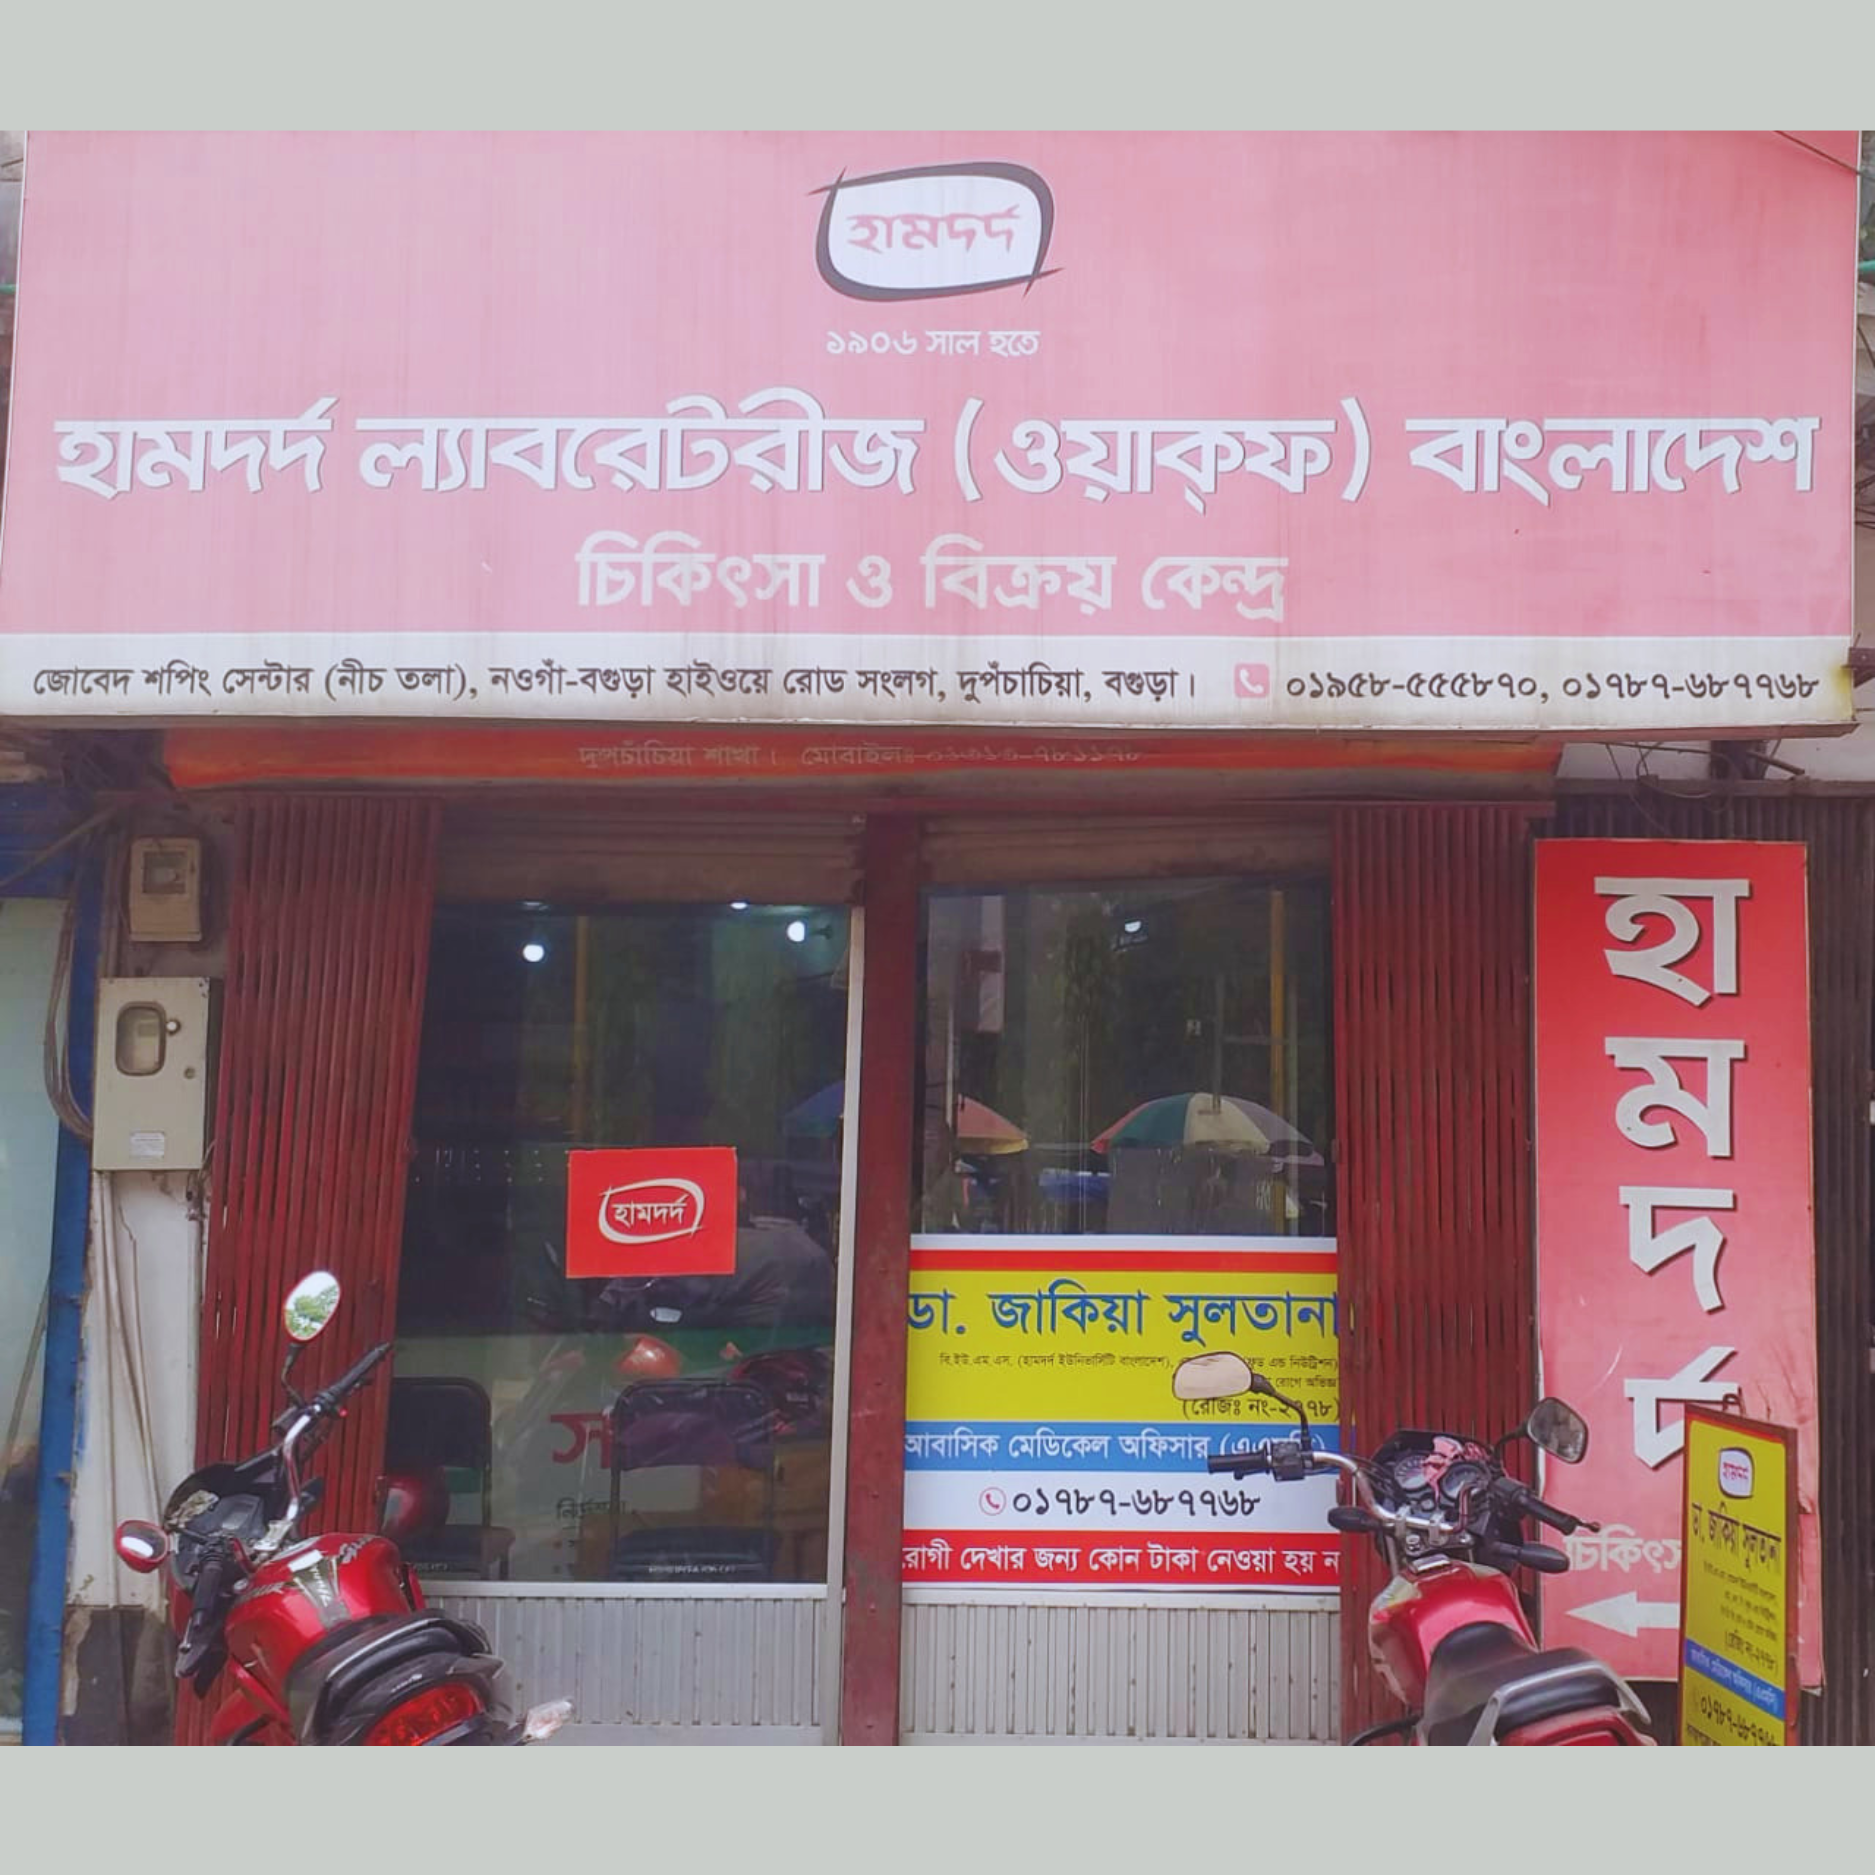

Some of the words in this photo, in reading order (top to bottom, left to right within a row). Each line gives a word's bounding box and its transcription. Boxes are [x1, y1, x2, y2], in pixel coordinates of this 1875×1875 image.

[846, 204, 1020, 254] হামদর্দ
[826, 330, 918, 355] ১৯০৬
[925, 331, 982, 356] সাল
[988, 331, 1042, 357] হতে
[55, 396, 341, 501] হামদর্দ
[356, 387, 927, 496] ল্যাবরেটরীজ
[1406, 417, 1822, 507] বাংলাদেশ
[574, 530, 826, 609] চিকিৎসা
[847, 555, 894, 609] ও
[921, 534, 1117, 615] বিক্রয়
[1141, 556, 1289, 624] কেন্দ্র
[33, 665, 134, 695] জোবেদ
[143, 659, 212, 696] শপিং
[223, 662, 315, 695] সেন্টার
[325, 658, 384, 702] (নীচ
[395, 662, 477, 702] তলা),
[663, 659, 772, 698] হাইওয়ে
[783, 668, 847, 697] রোড
[1286, 671, 1549, 704] ০১৯৫৮-৫৫৫৮৭০,
[1563, 671, 1820, 699] ০১৭৮৭-৬৮৭৭৬৮
[612, 1194, 690, 1226] হামদর্দ
[907, 1289, 966, 1335] ডা.
[987, 1278, 1149, 1335] জাকিয়া
[1164, 1291, 1339, 1347] সুলতানা
[903, 1428, 999, 1461] আবাসিক
[1008, 1430, 1109, 1460] মেডিকেল
[1119, 1432, 1212, 1461] অফিসার
[1013, 1486, 1262, 1517] ০১৭৮৭-৬৮৭৭৬৮
[960, 1545, 1026, 1571] দেখার
[1034, 1545, 1080, 1572] জন্য
[1088, 1546, 1142, 1573] কোন
[1147, 1541, 1199, 1574] টাকা
[1206, 1547, 1276, 1575] নেওয়া
[1284, 1549, 1315, 1577] হয়
